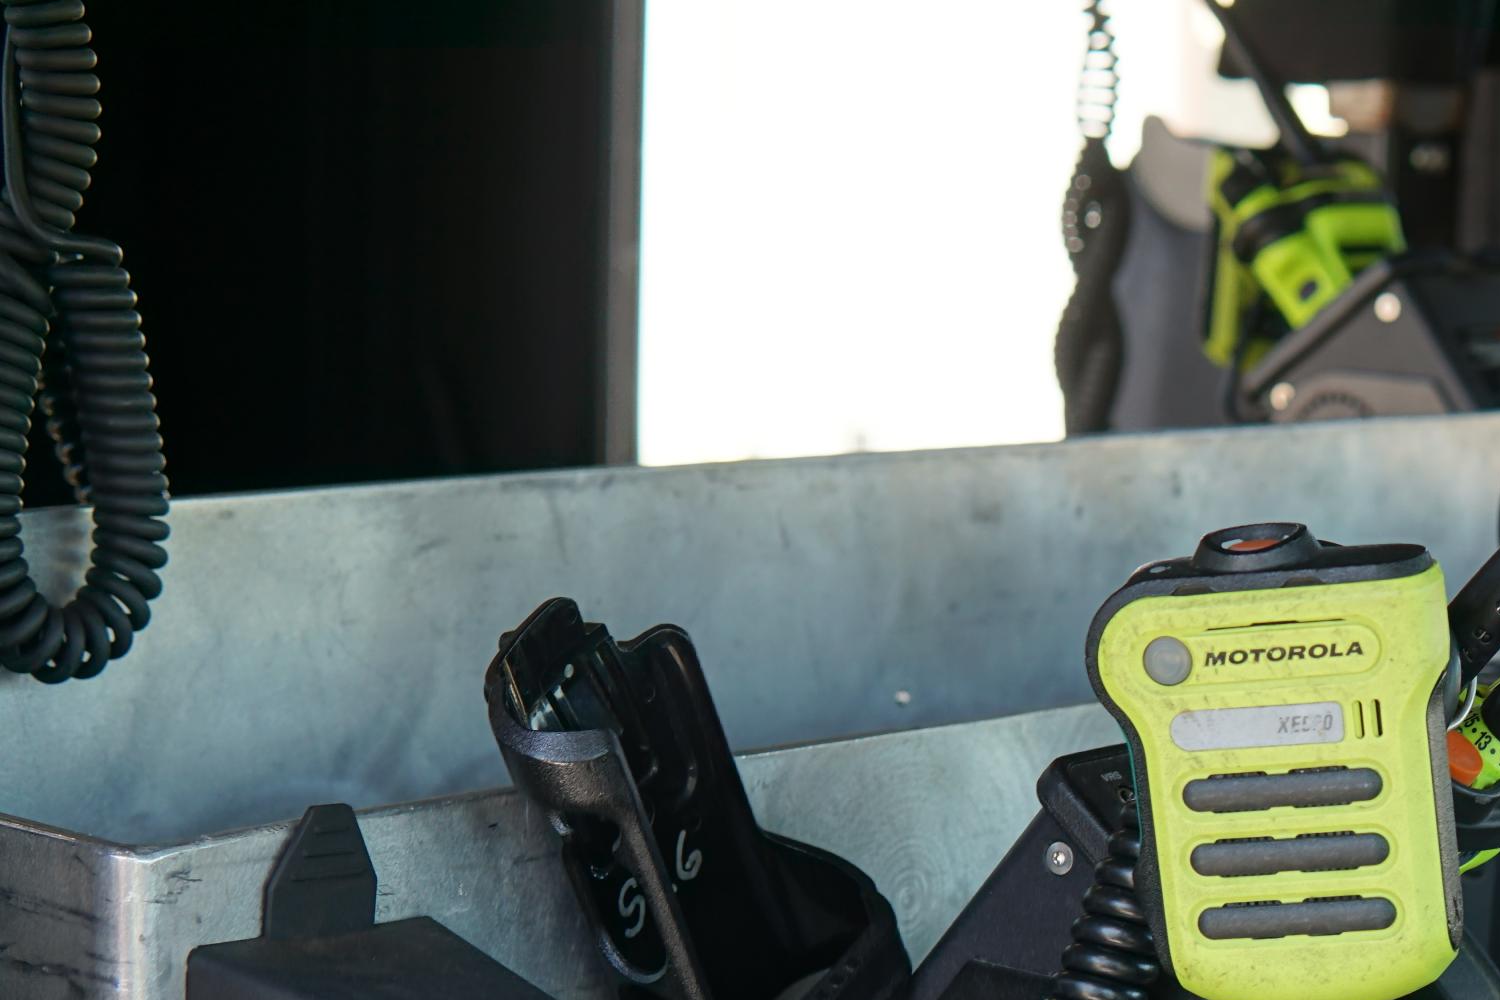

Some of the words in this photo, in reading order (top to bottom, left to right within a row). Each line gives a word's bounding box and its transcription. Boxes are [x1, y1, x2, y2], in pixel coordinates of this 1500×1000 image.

[1205, 641, 1364, 666] MOTOROLA
[1277, 713, 1334, 734] XE50
[1475, 731, 1493, 751] 13
